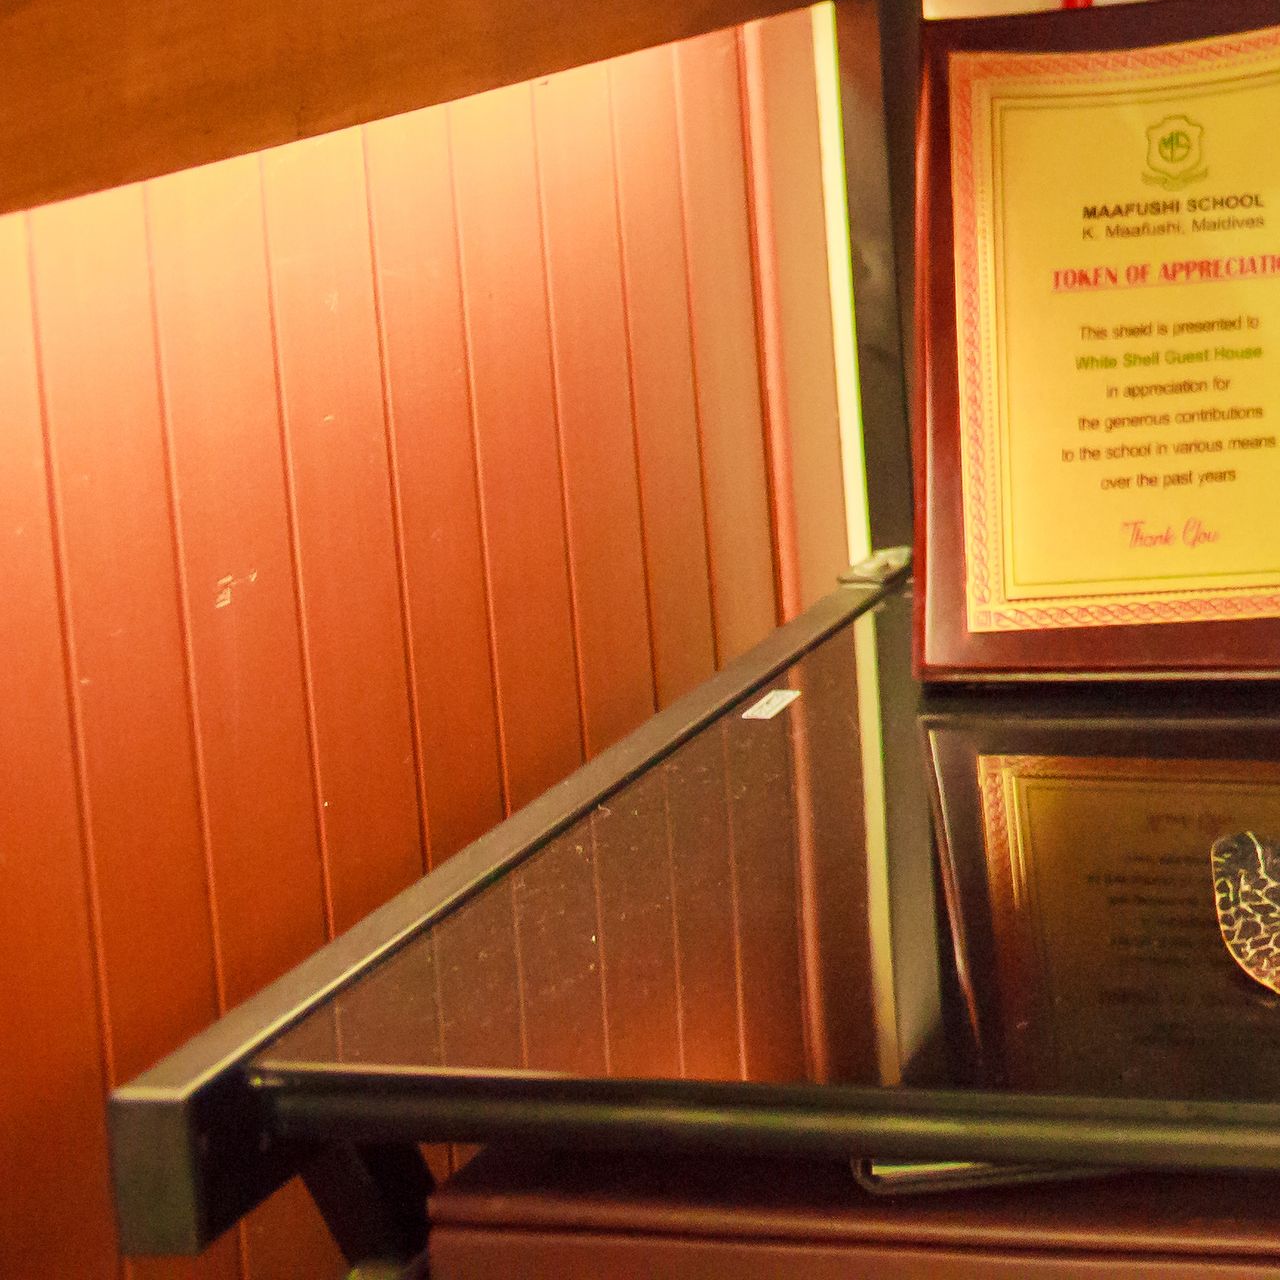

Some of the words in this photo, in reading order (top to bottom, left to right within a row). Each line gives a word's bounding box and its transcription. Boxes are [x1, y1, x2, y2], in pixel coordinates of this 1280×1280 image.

[1082, 202, 1180, 221] MAAFUSHI
[1187, 193, 1265, 213] SCHOOL
[1191, 214, 1265, 234] Maldives
[1053, 266, 1118, 290] TOKEN
[1126, 263, 1151, 285] OF
[1080, 325, 1107, 341] This
[1112, 321, 1152, 339] shield
[1157, 322, 1168, 336] is
[1173, 316, 1242, 340] presented
[1247, 315, 1259, 331] to
[1076, 353, 1117, 370] White
[1123, 350, 1160, 368] Shell
[1164, 348, 1209, 366] Guest
[1214, 345, 1262, 361] House
[1106, 383, 1118, 398] in
[1123, 378, 1208, 400] appreciation
[1213, 376, 1232, 392] for
[1078, 415, 1099, 432] the
[1104, 413, 1170, 434] generous
[1175, 405, 1264, 427] contributions
[1061, 447, 1074, 463] to
[1079, 445, 1101, 461] the
[1106, 441, 1151, 459] school
[1156, 440, 1168, 456] in
[1173, 437, 1223, 456] various
[1228, 434, 1276, 451] means
[1100, 476, 1131, 491] over
[1136, 472, 1157, 488] the
[1163, 471, 1192, 491] past
[1198, 468, 1236, 489] years
